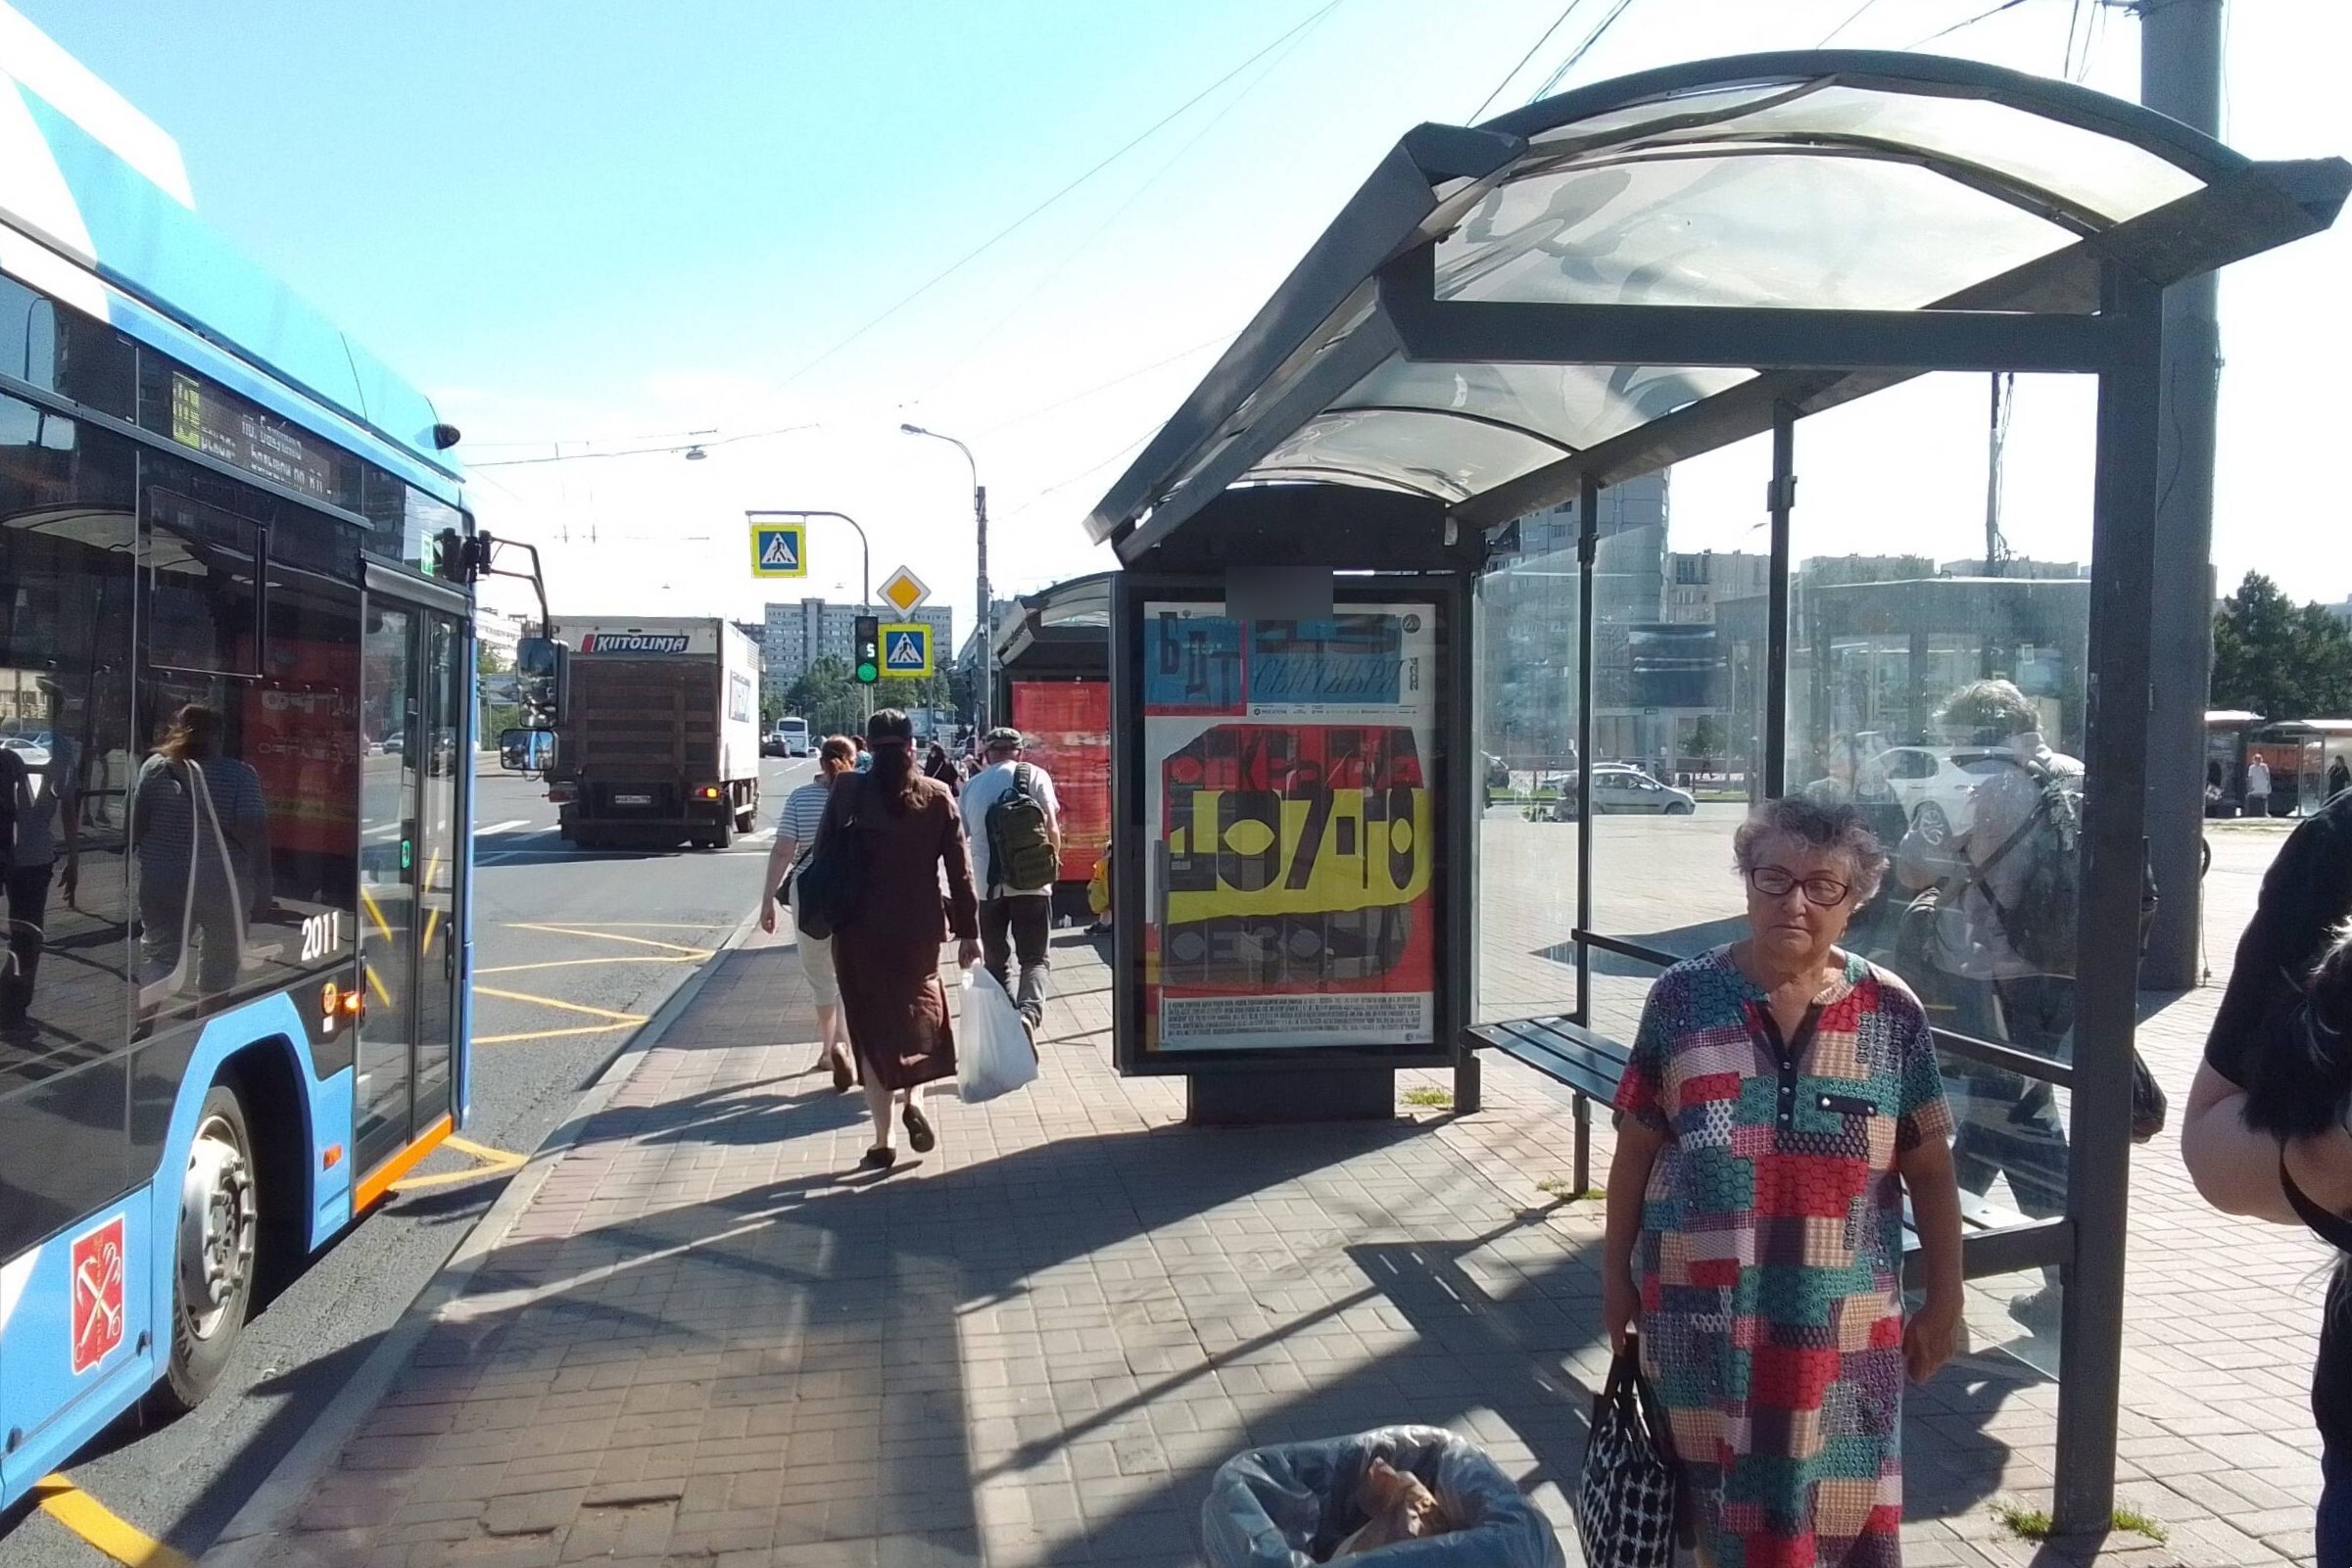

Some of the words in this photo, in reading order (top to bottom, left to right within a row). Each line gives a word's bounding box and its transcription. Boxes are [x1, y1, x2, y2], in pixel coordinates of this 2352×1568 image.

[598, 636, 687, 652] KIITOLINJA
[1410, 657, 1419, 691] 2024
[302, 911, 338, 961] 2011
